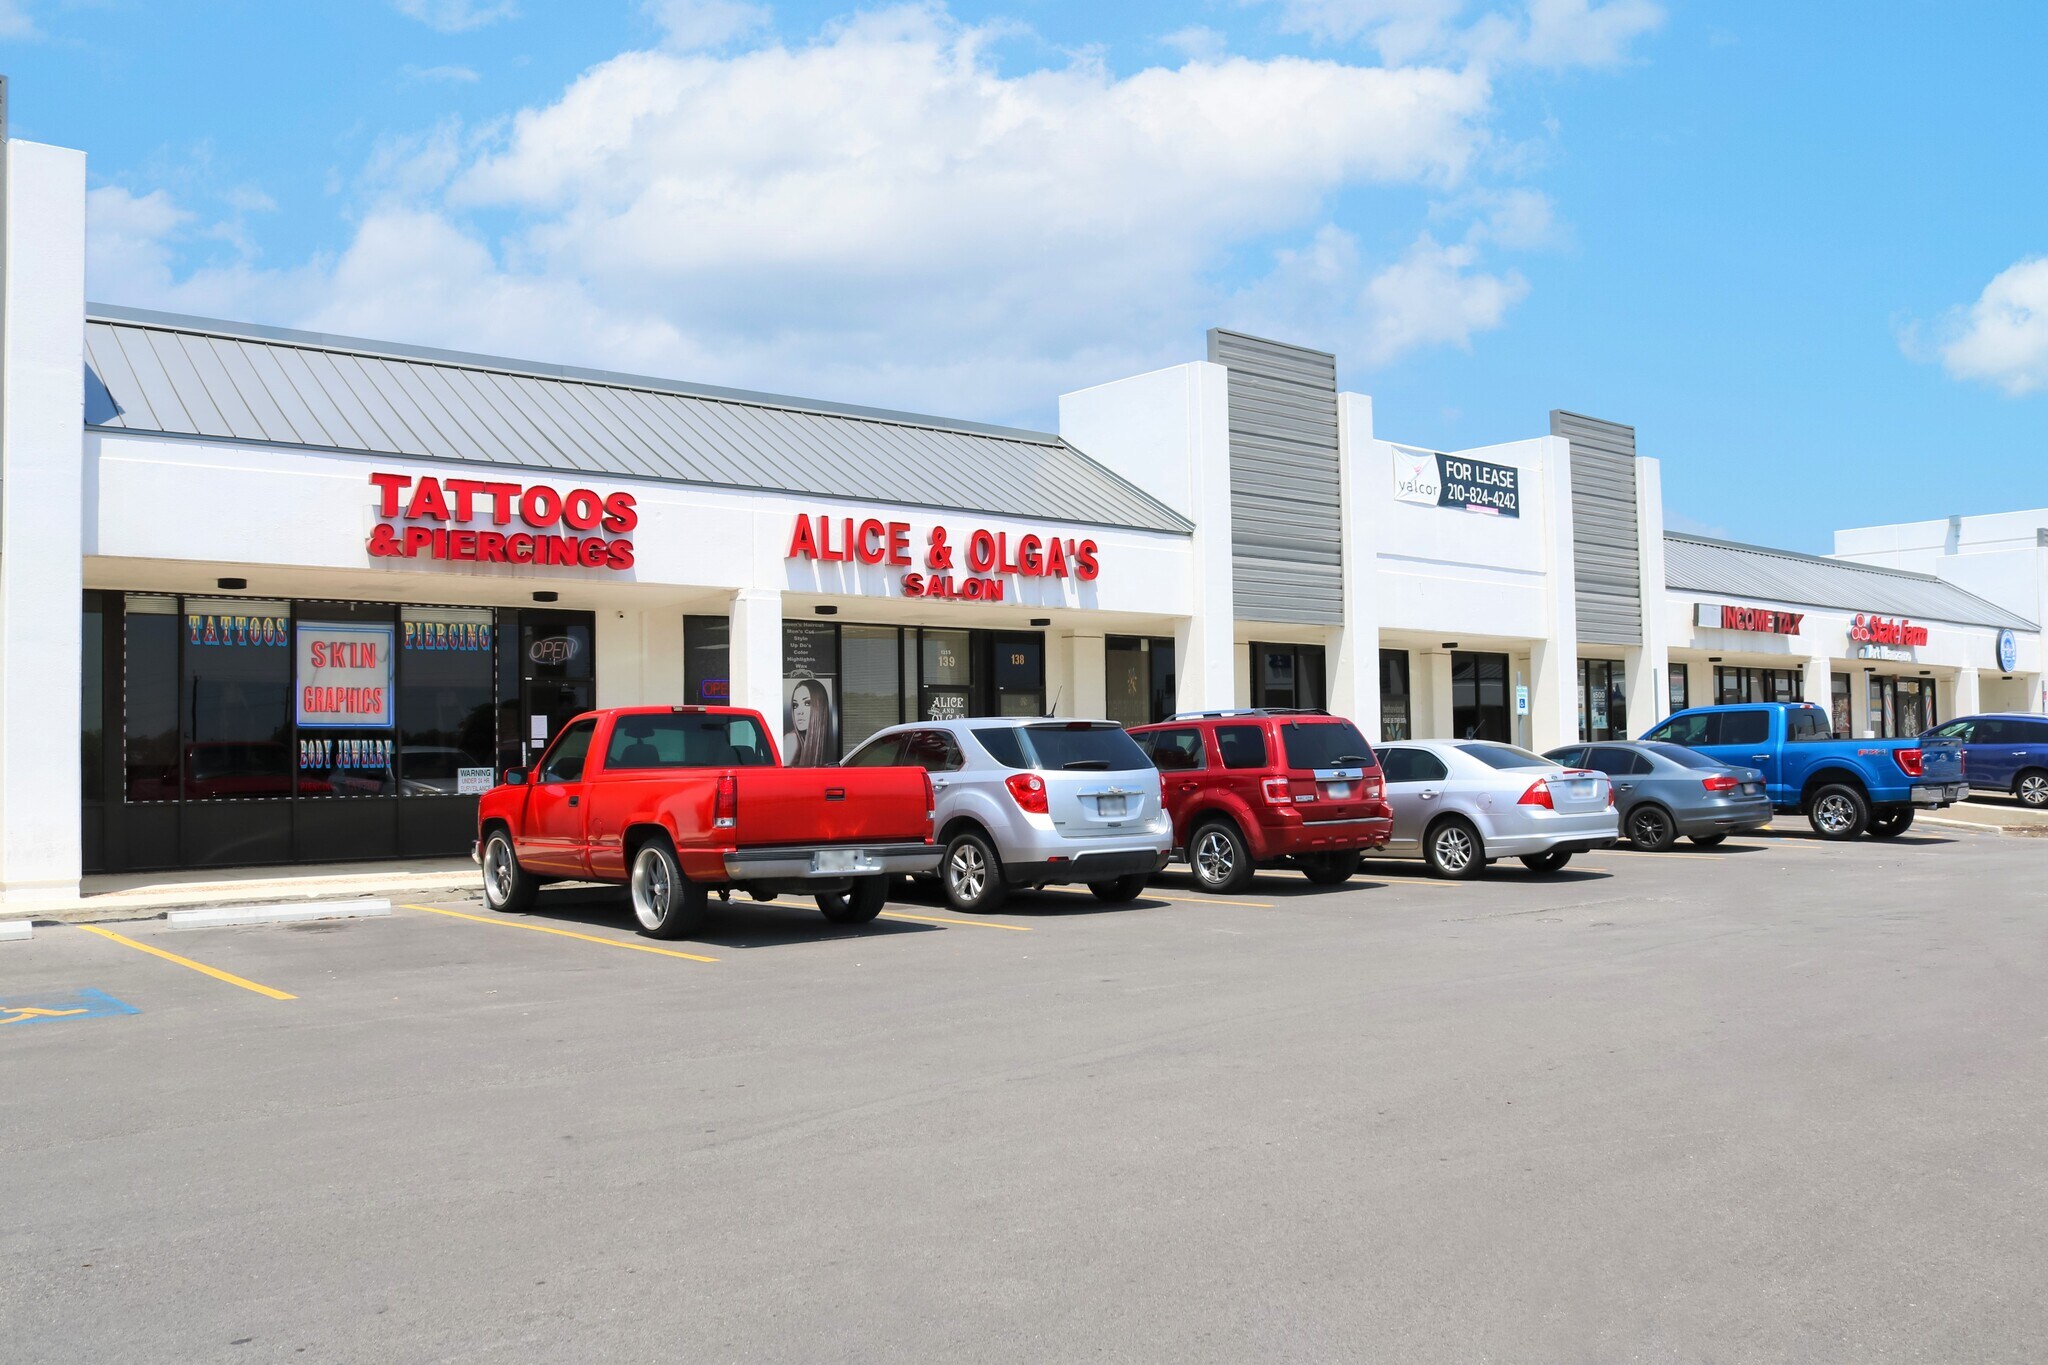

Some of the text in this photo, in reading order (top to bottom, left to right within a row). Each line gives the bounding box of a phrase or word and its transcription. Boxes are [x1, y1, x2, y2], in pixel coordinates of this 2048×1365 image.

[1399, 480, 1437, 496] valcor
[1446, 461, 1515, 488] FOR LEASE
[369, 472, 638, 533] TATTOOS
[1447, 483, 1516, 509] 210-824-4242
[784, 513, 1099, 581] ALICE & OLGA'S
[902, 573, 1003, 601] SALON
[188, 615, 289, 647] TATTOOS
[1722, 605, 1804, 636] INCOME TAX
[1870, 615, 1928, 646] State Farm
[404, 621, 491, 651] PIERCING
[531, 641, 574, 659] OPEN
[311, 640, 376, 668] SKIN
[938, 656, 956, 667] 139
[1011, 654, 1025, 665] 138
[304, 686, 382, 714] GRAPHICS
[703, 681, 730, 696] OPE
[932, 696, 964, 708] ALICE
[300, 739, 393, 769] BODY JEWELRY
[460, 769, 491, 777] WARNING
